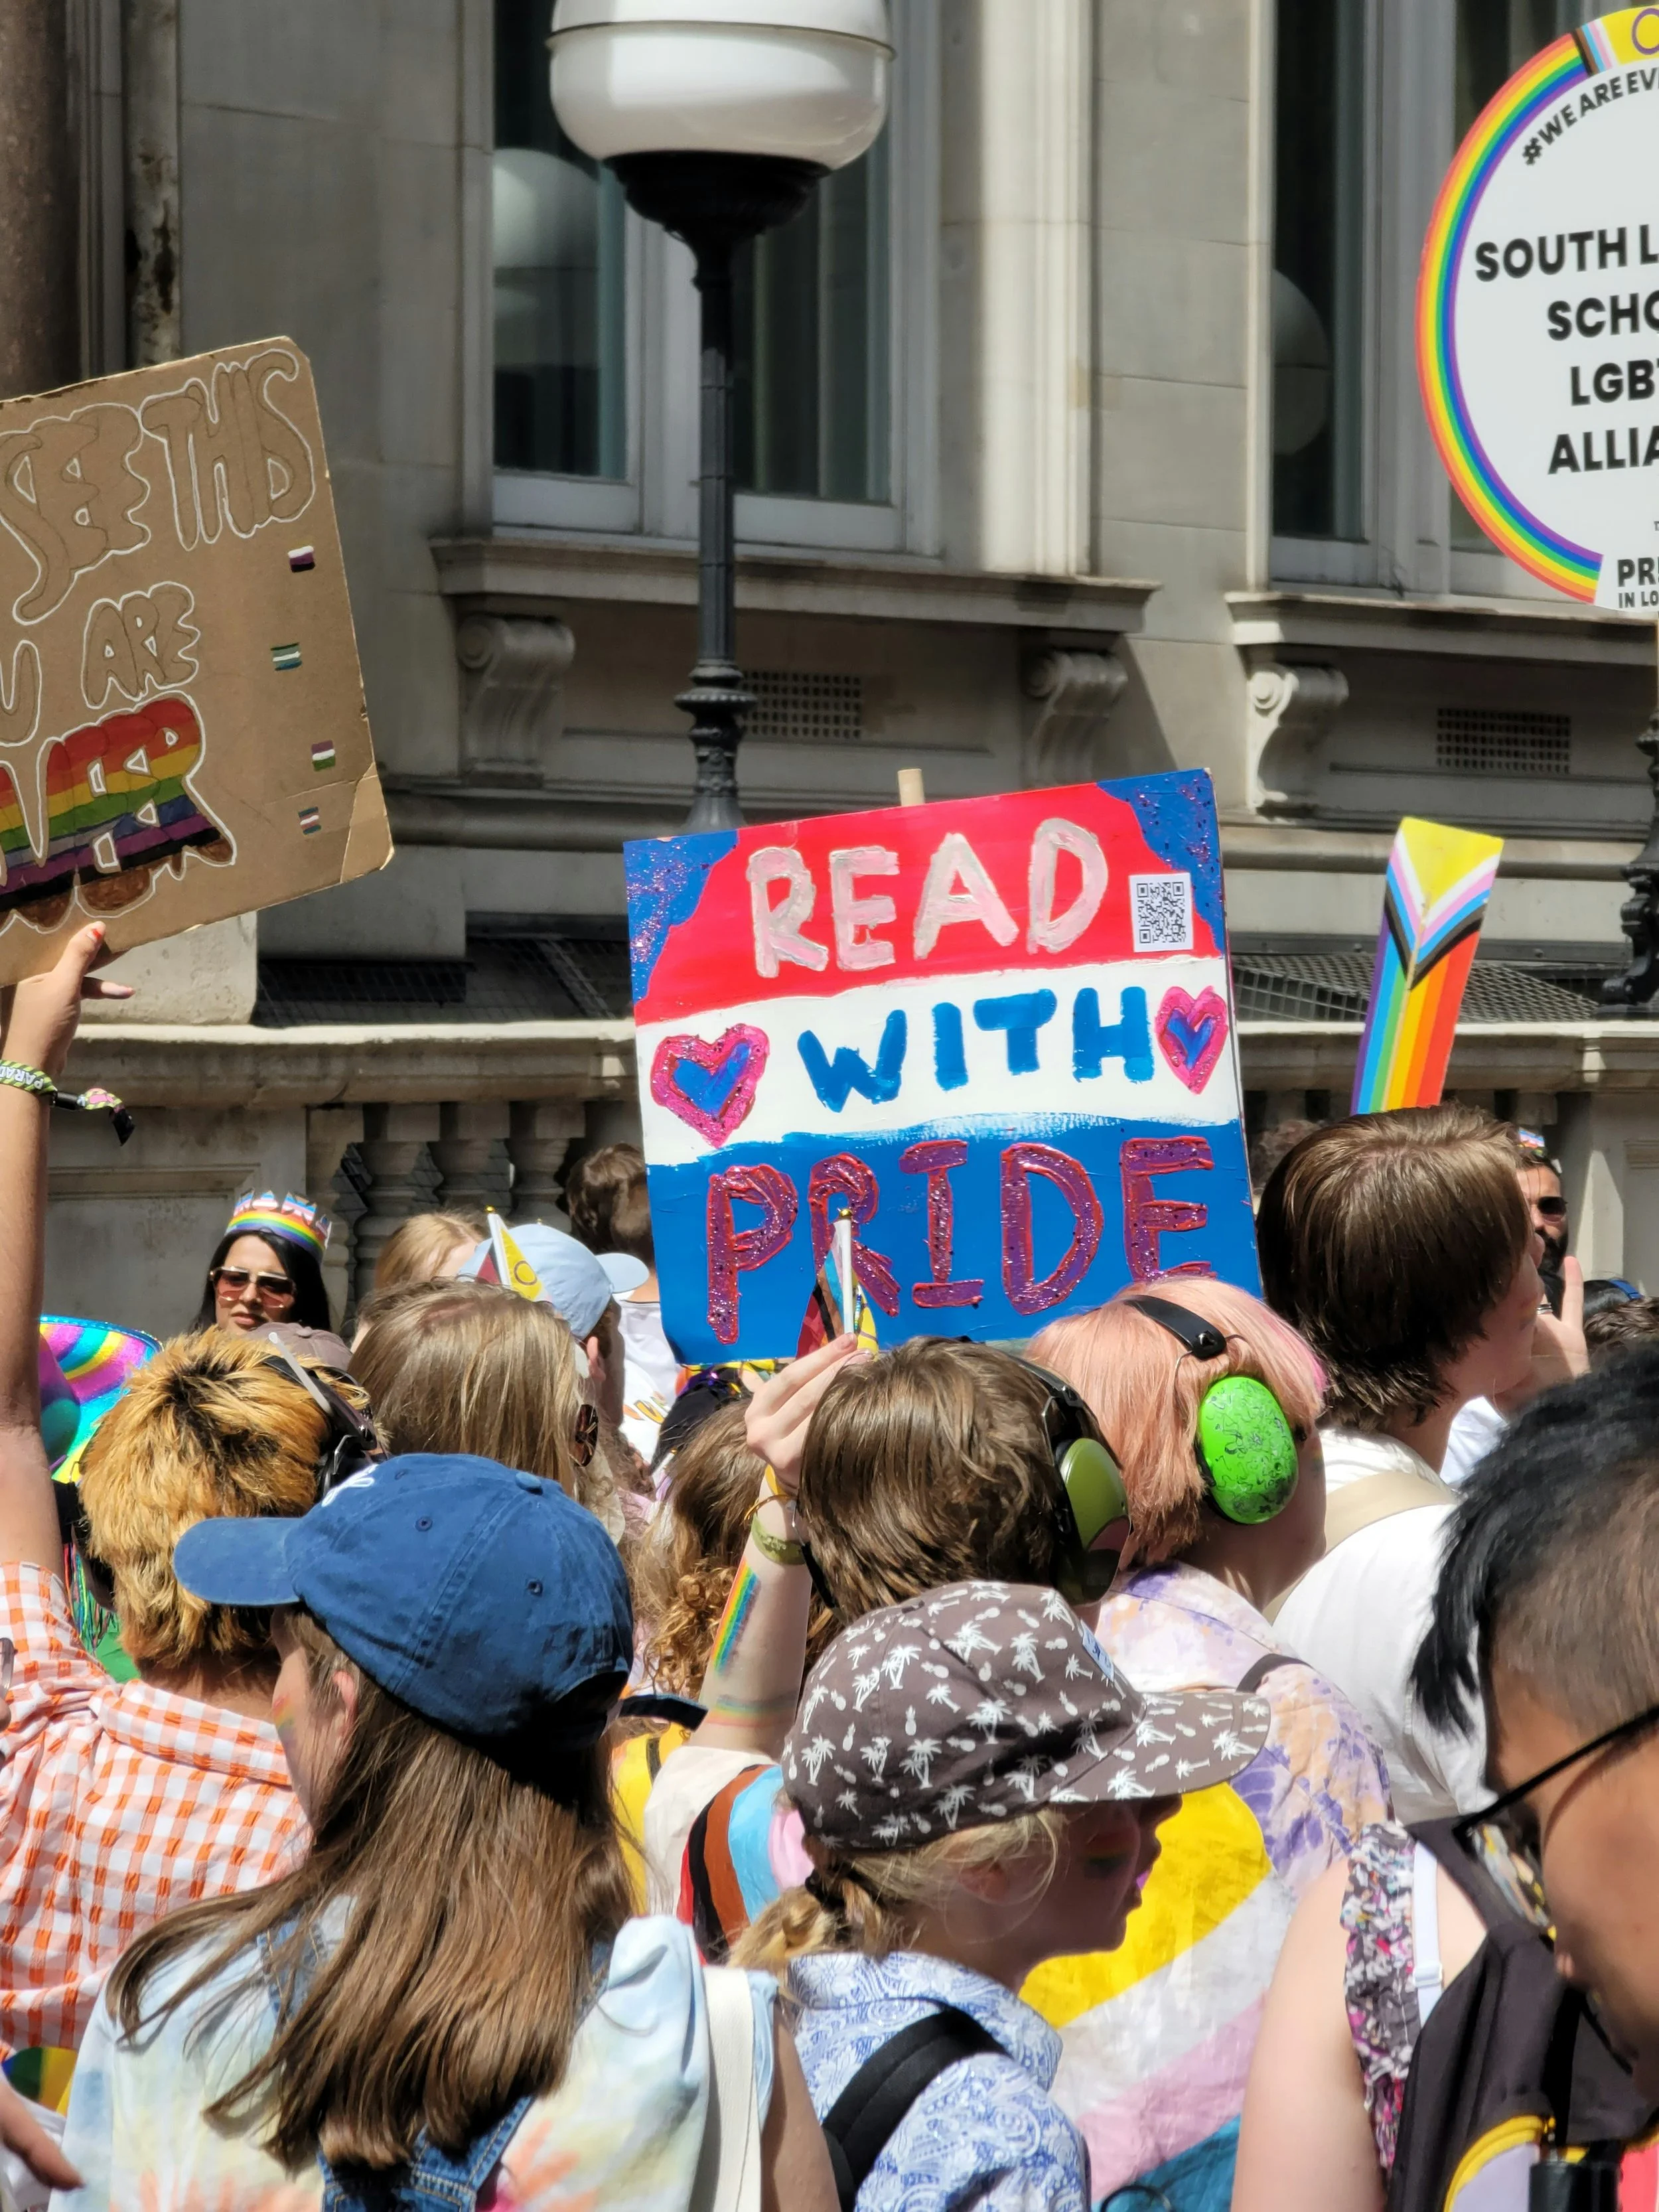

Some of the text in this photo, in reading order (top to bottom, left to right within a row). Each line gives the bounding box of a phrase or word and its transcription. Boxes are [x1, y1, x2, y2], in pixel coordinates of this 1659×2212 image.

[1626, 66, 1659, 95] EV
[1475, 226, 1628, 282] SOUTH
[1570, 358, 1659, 407] LGB
[139, 348, 315, 551] THIS
[1617, 557, 1659, 587] PR
[1618, 591, 1636, 609] IN
[81, 581, 200, 709] ARE
[747, 818, 1109, 978] READ
[796, 986, 1155, 1112] WITH
[707, 1136, 1216, 1345] PRIDE
